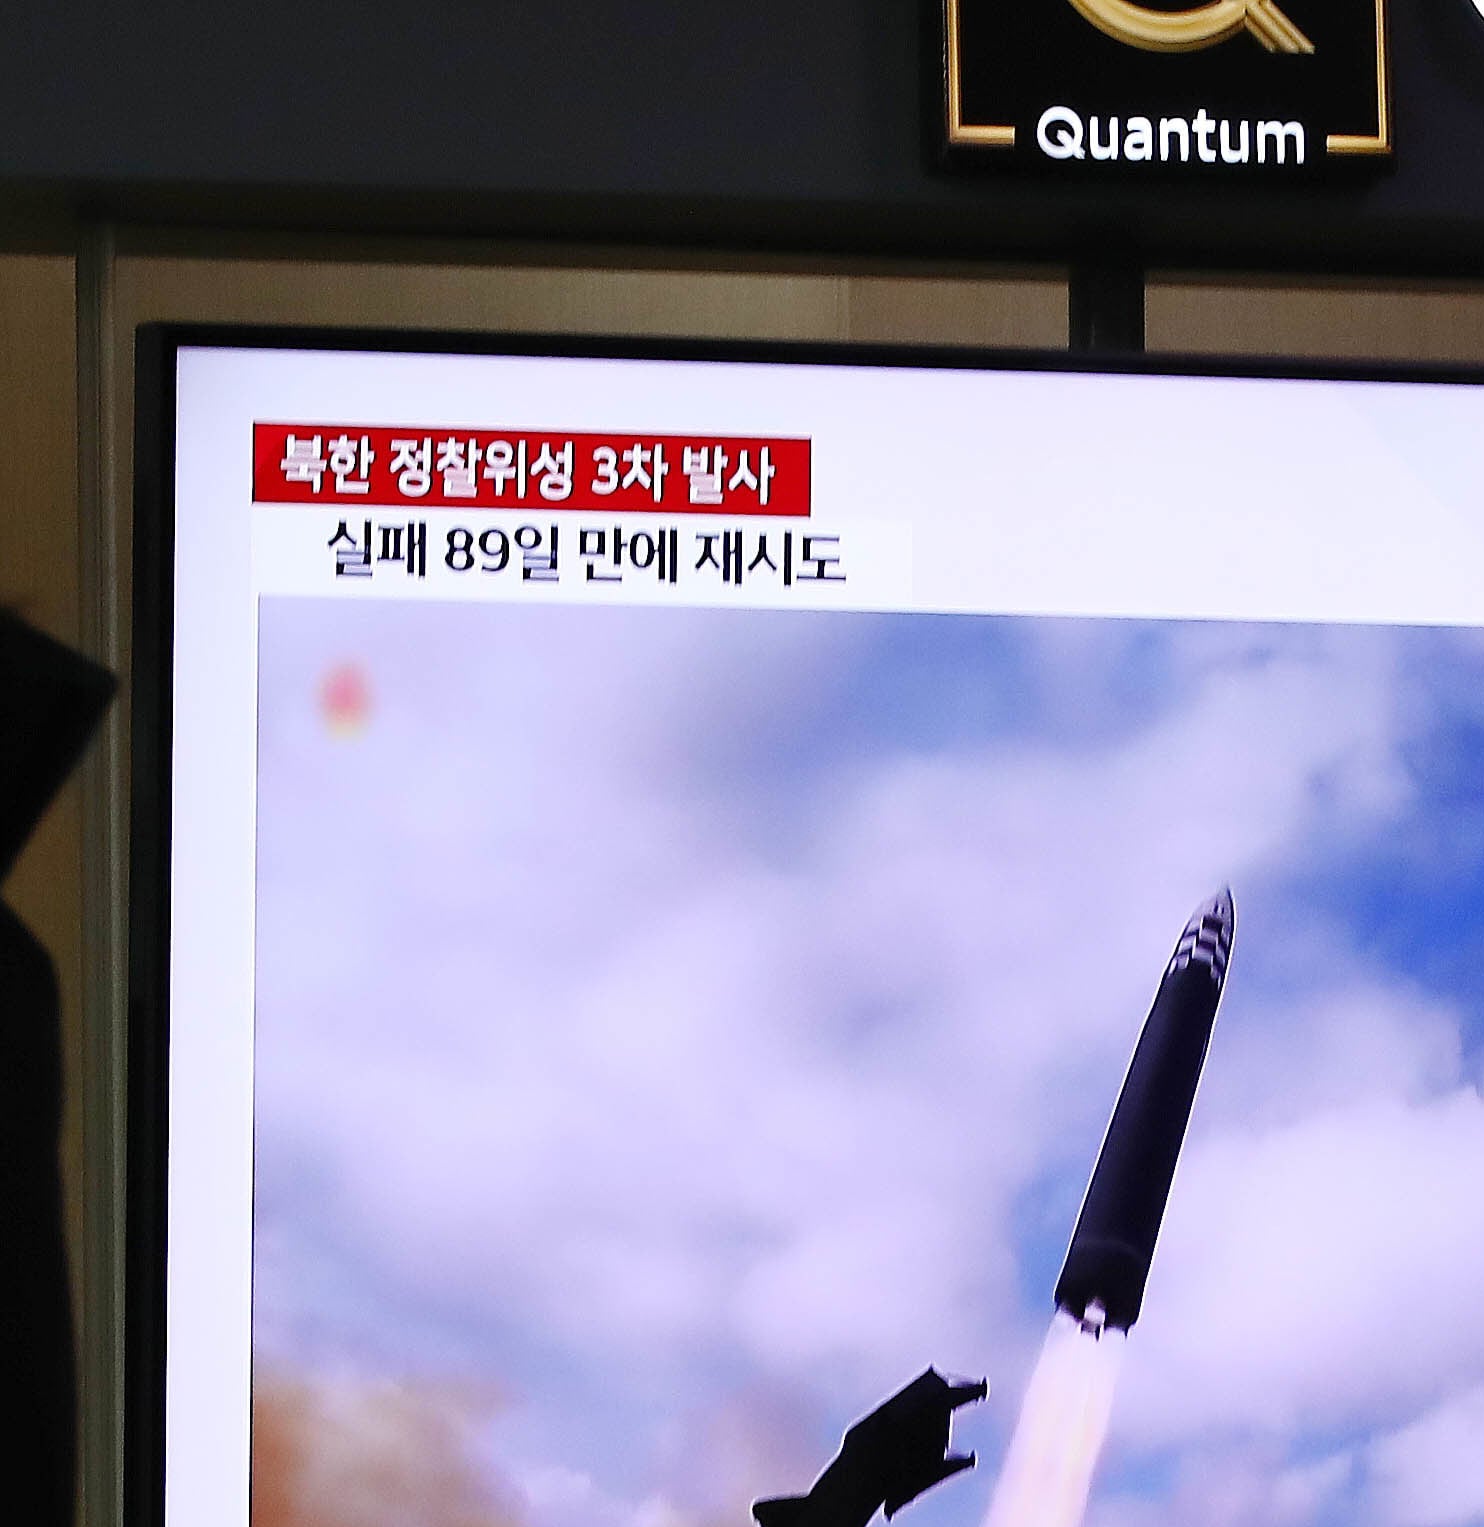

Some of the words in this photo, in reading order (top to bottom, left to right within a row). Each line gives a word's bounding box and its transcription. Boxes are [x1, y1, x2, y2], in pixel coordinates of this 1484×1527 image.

[1036, 105, 1305, 164] Quantum
[281, 434, 375, 494] 북한
[389, 435, 575, 500] 정찰위성
[591, 445, 668, 503] 3차
[681, 444, 776, 506] 발사
[328, 520, 426, 579] 실패
[444, 525, 560, 582] 89일
[579, 527, 677, 585] 만에
[694, 530, 847, 586] 재시도
